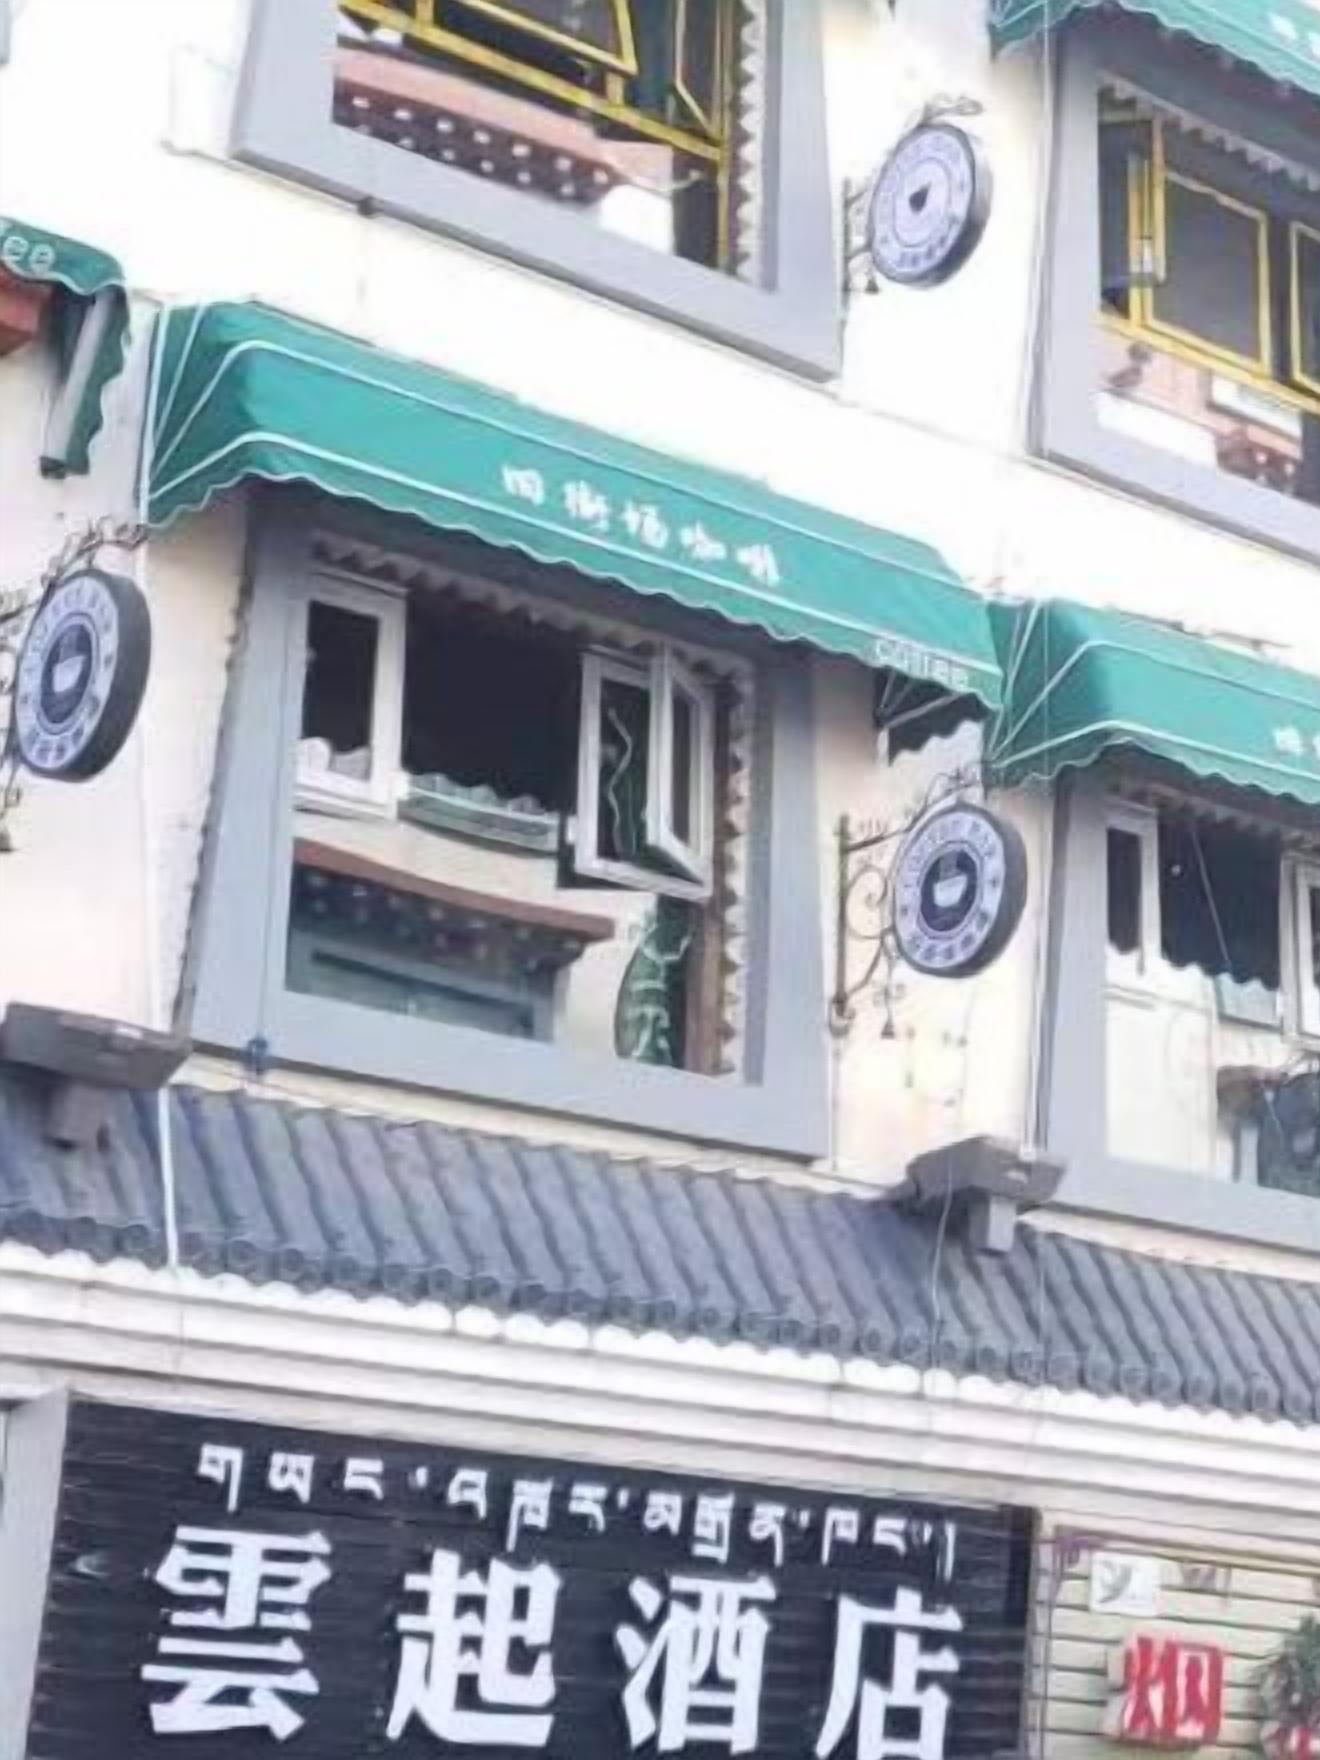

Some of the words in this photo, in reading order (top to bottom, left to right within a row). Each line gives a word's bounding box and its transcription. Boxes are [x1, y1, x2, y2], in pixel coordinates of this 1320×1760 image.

[141, 1525, 964, 1760] 雲起酒店
[1121, 1634, 1223, 1746] 烟
